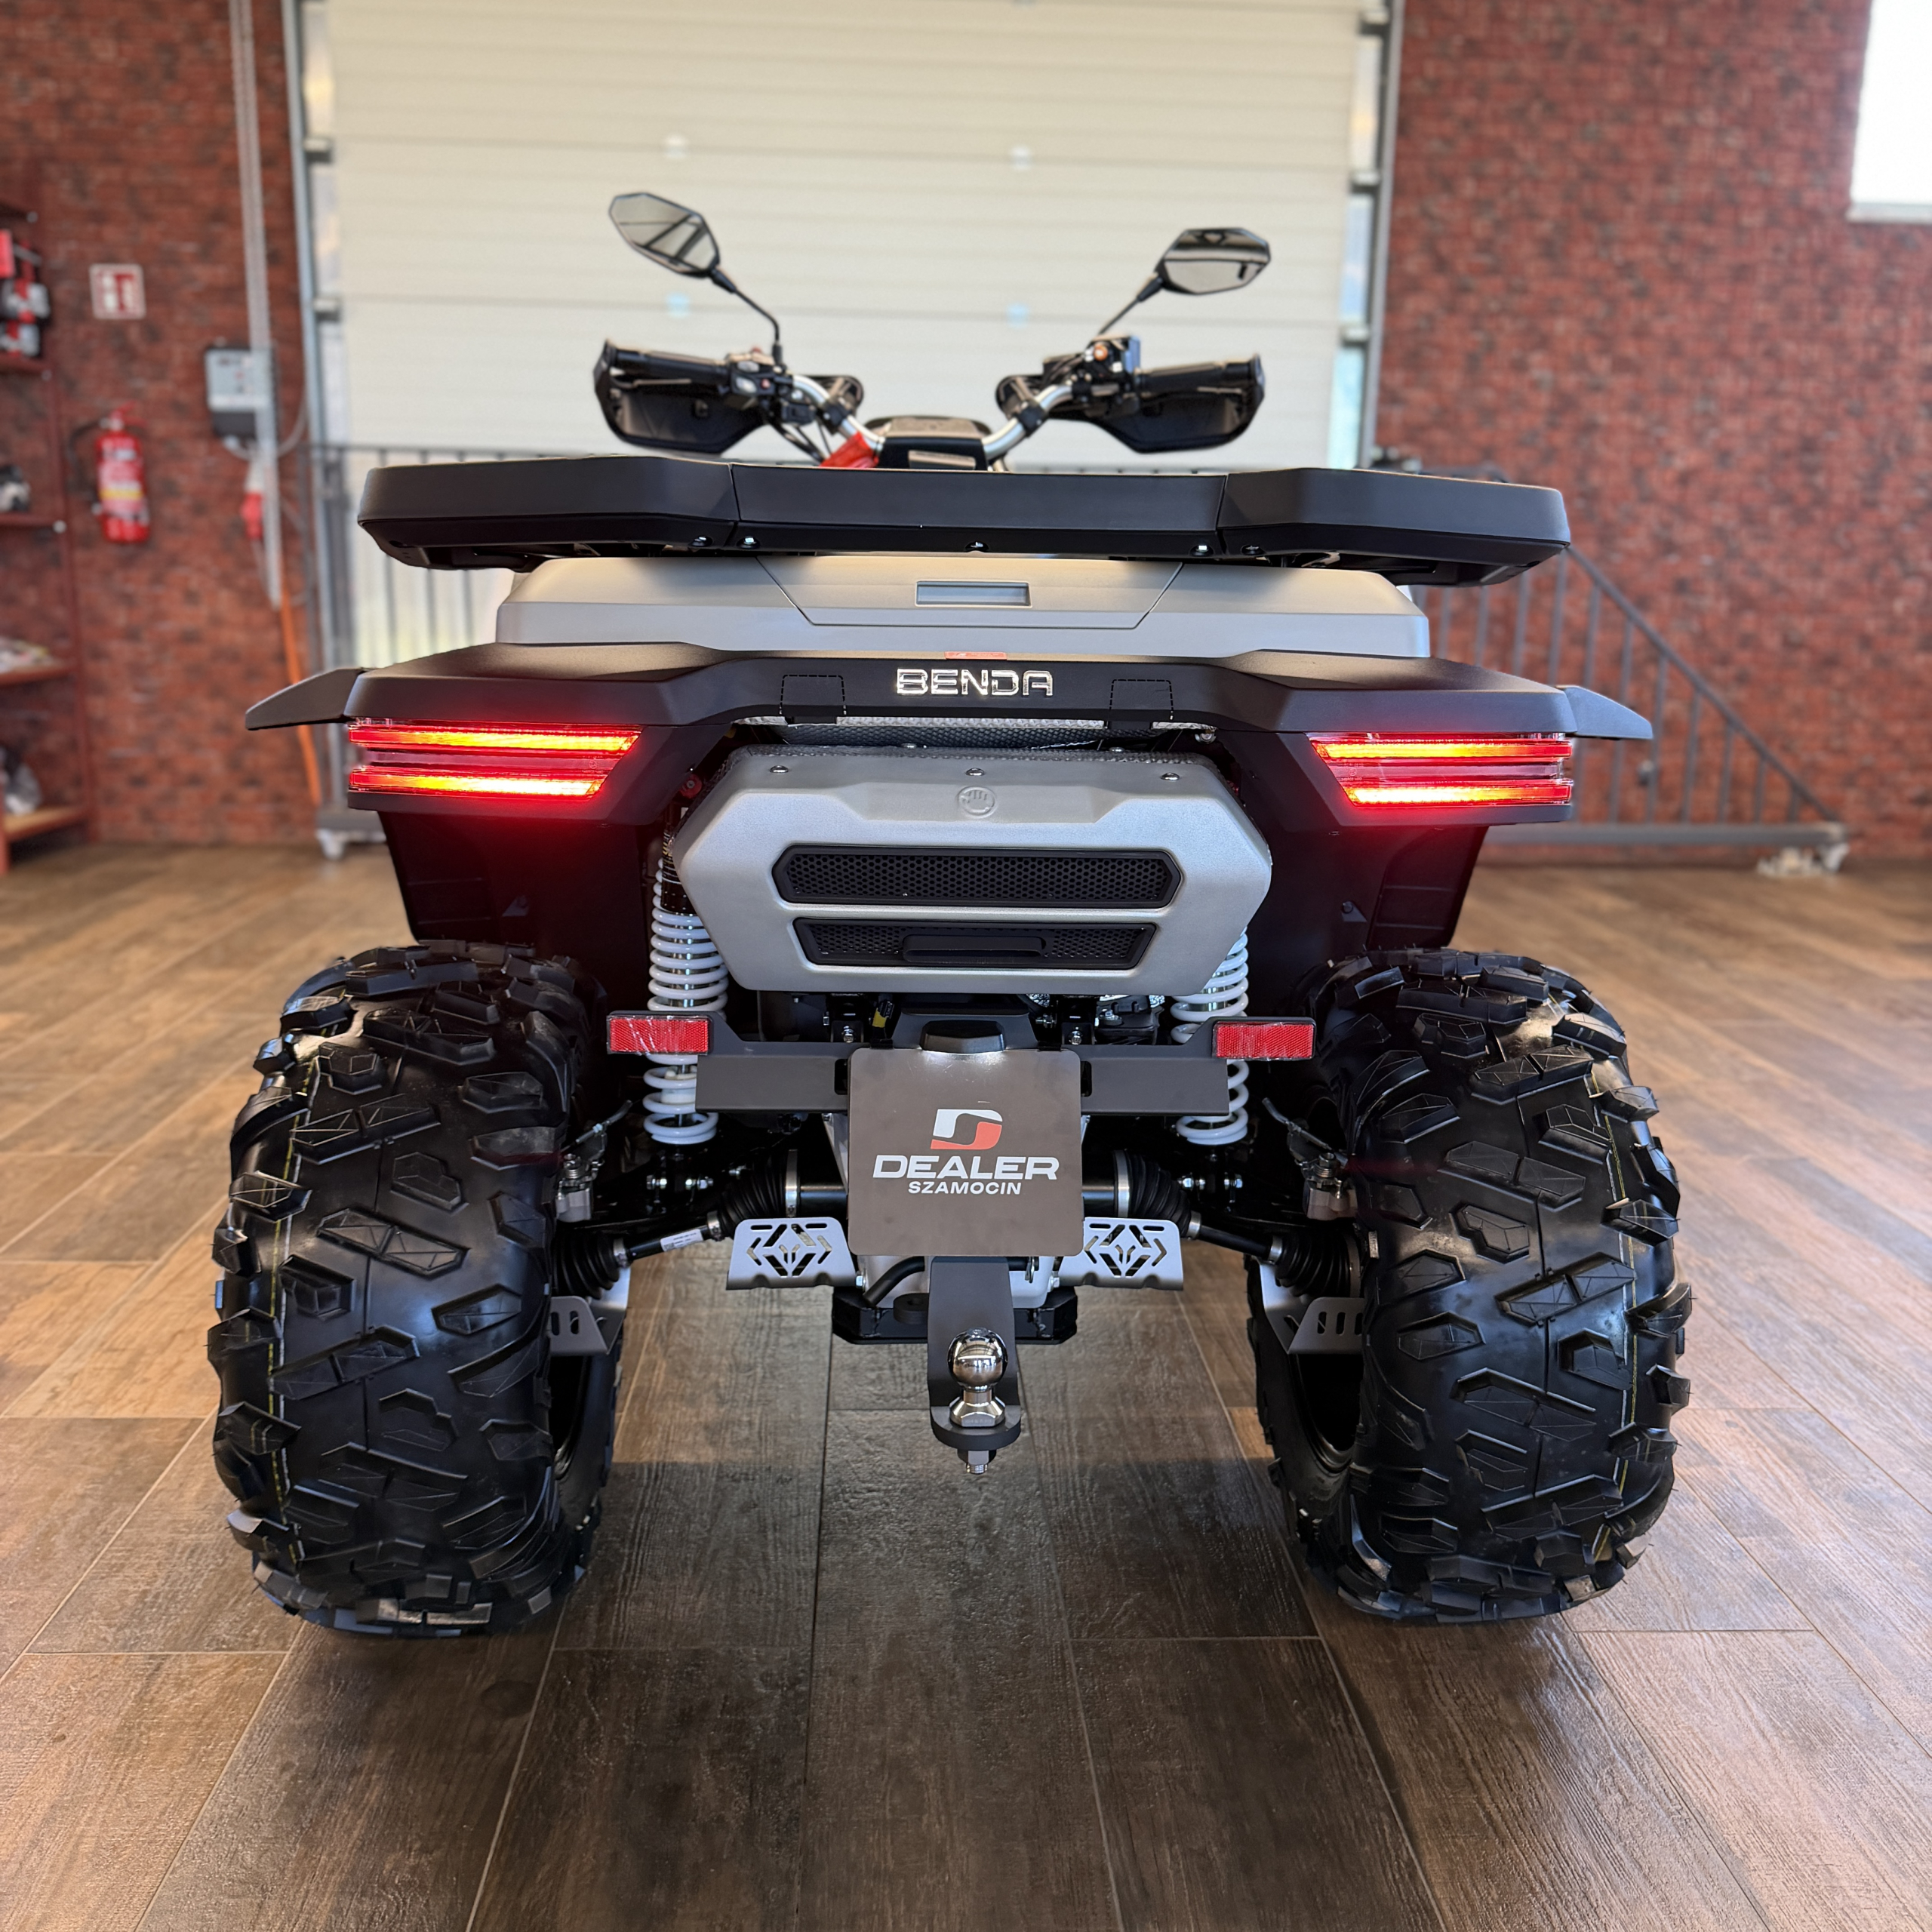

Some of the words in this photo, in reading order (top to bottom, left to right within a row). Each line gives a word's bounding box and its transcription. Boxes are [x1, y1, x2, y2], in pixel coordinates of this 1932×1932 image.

[897, 669, 1053, 695] BENDA
[872, 1155, 1059, 1180] DEALER
[908, 1181, 1021, 1194] SZAMOCIN
